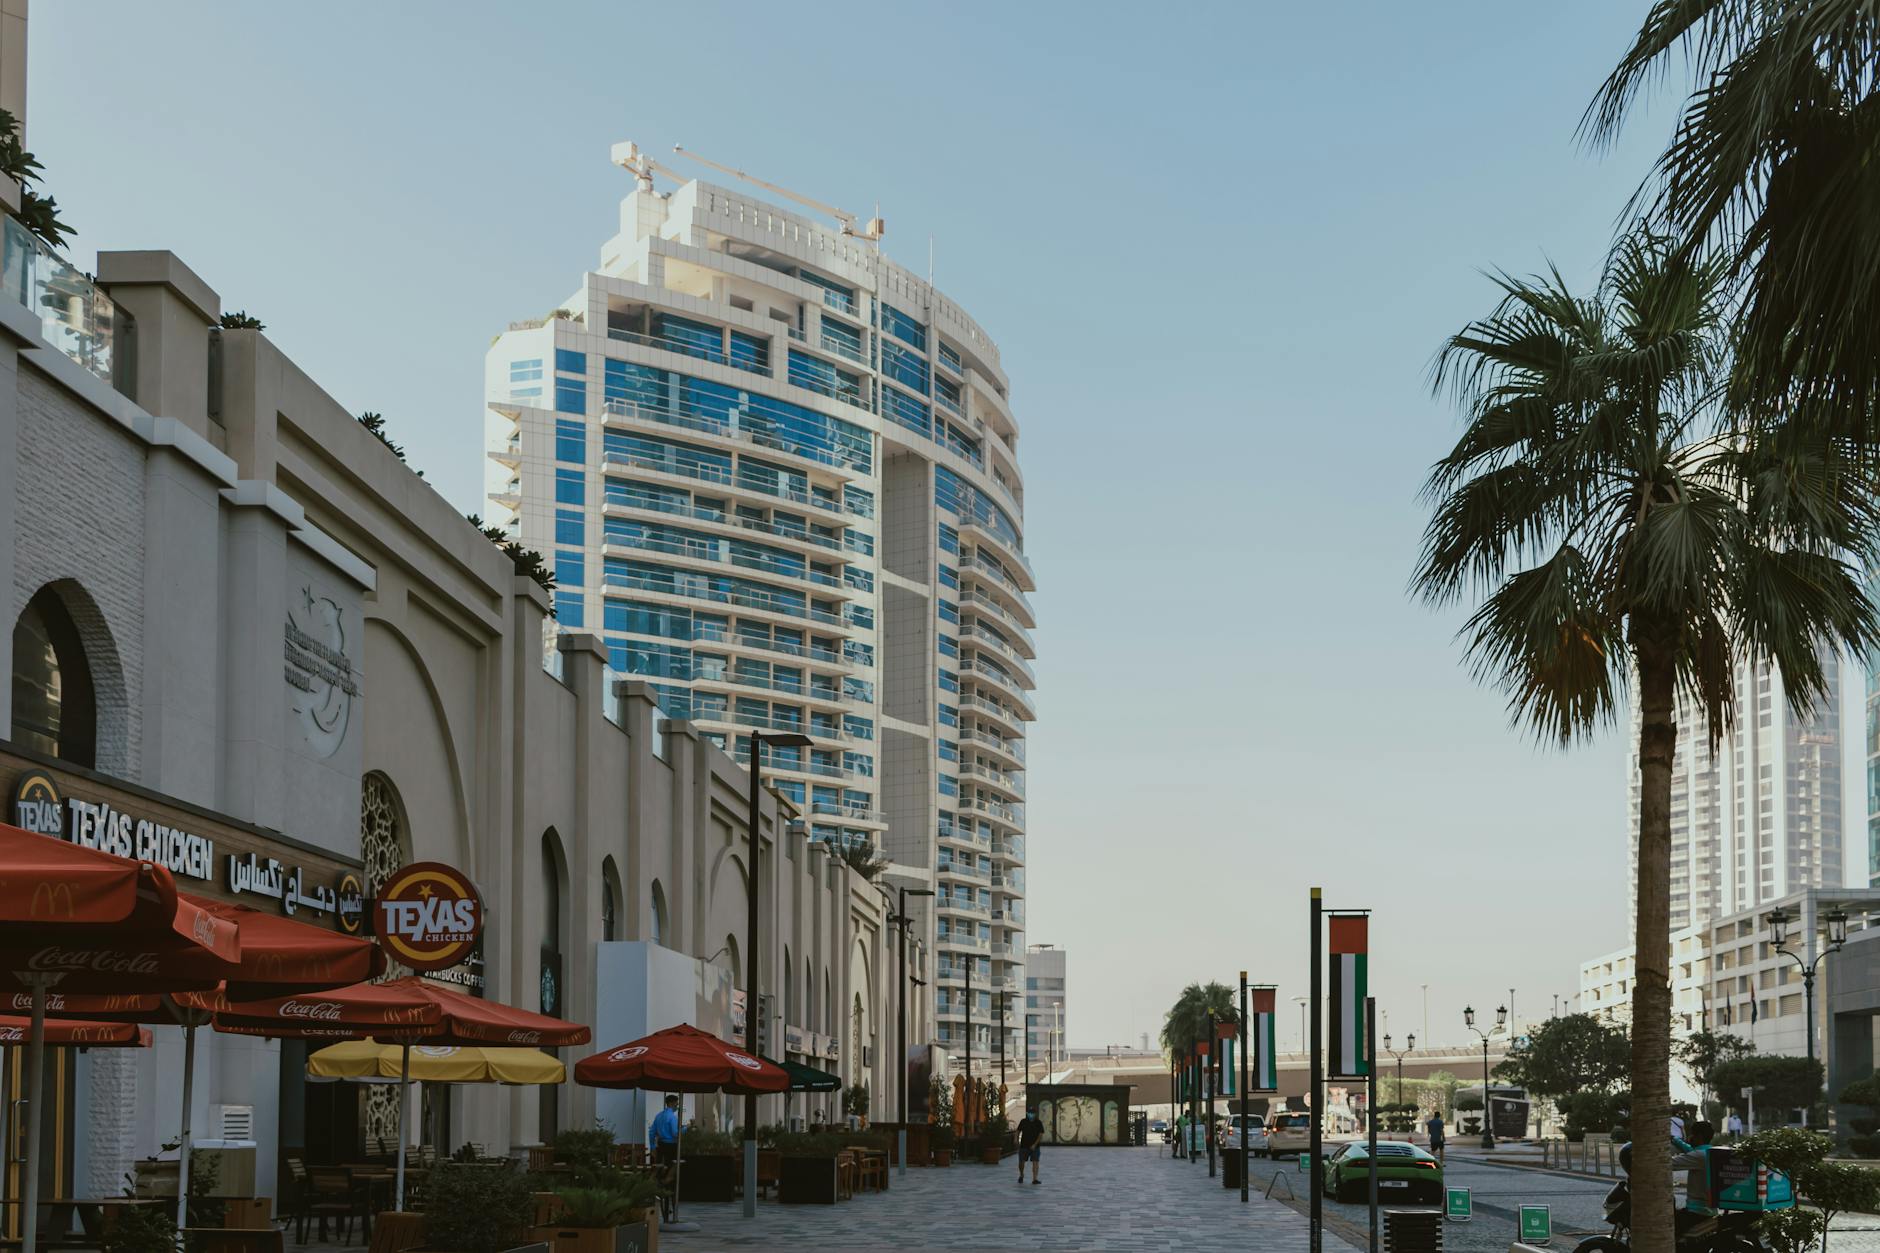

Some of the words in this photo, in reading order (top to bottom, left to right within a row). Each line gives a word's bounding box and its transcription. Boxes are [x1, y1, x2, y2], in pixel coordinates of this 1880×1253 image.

[18, 799, 62, 833] TEXAS
[69, 797, 133, 859] TEXAS
[137, 819, 213, 881] CHICKEN
[230, 853, 284, 899] تكساس
[284, 866, 336, 917] دجاج
[382, 896, 475, 942] TEXAS
[425, 933, 474, 942] CHICKEN
[28, 945, 160, 975] Coca-Cola
[279, 1000, 345, 1020] Coca-Cola
